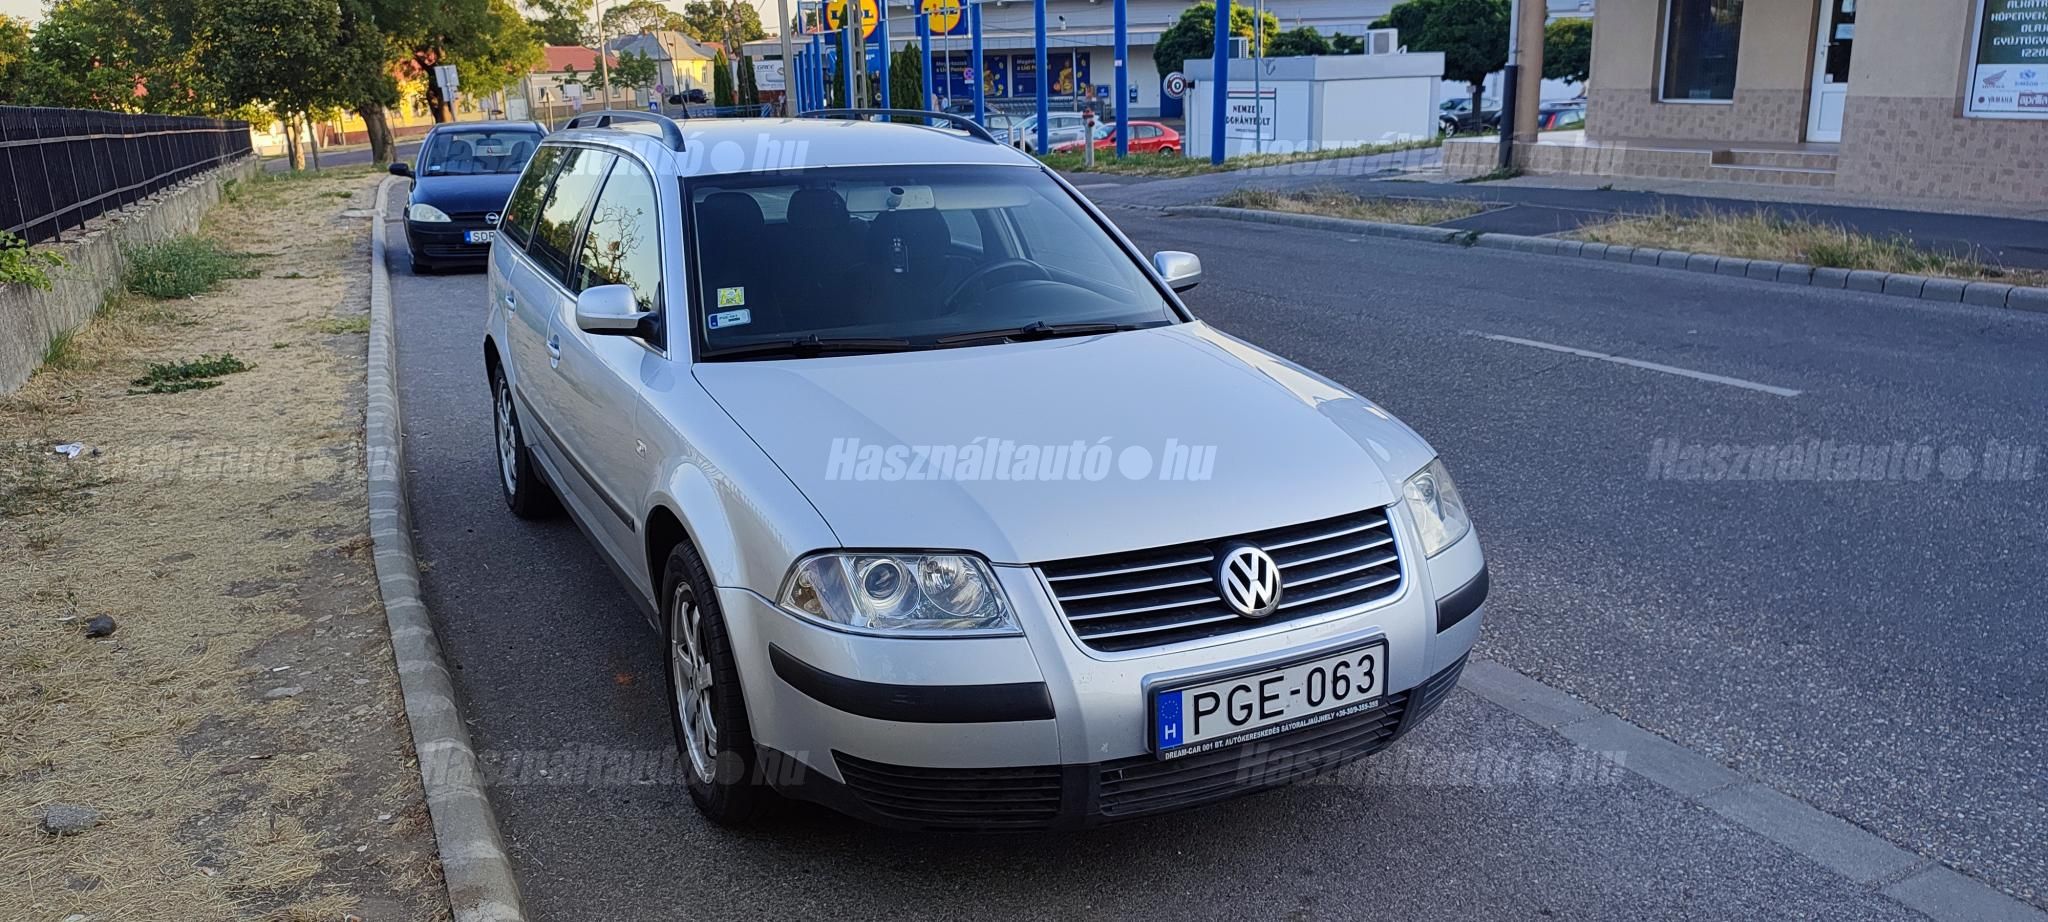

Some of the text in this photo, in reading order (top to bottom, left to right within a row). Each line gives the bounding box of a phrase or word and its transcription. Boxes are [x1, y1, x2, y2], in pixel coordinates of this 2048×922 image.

[1232, 104, 1263, 114] NEMZEI
[1193, 654, 1375, 736] PGE-063
[1165, 722, 1177, 740] H
[1165, 745, 1202, 760] DREAM-CAR
[1225, 726, 1280, 746] AUTÓKERESKEDÉS
